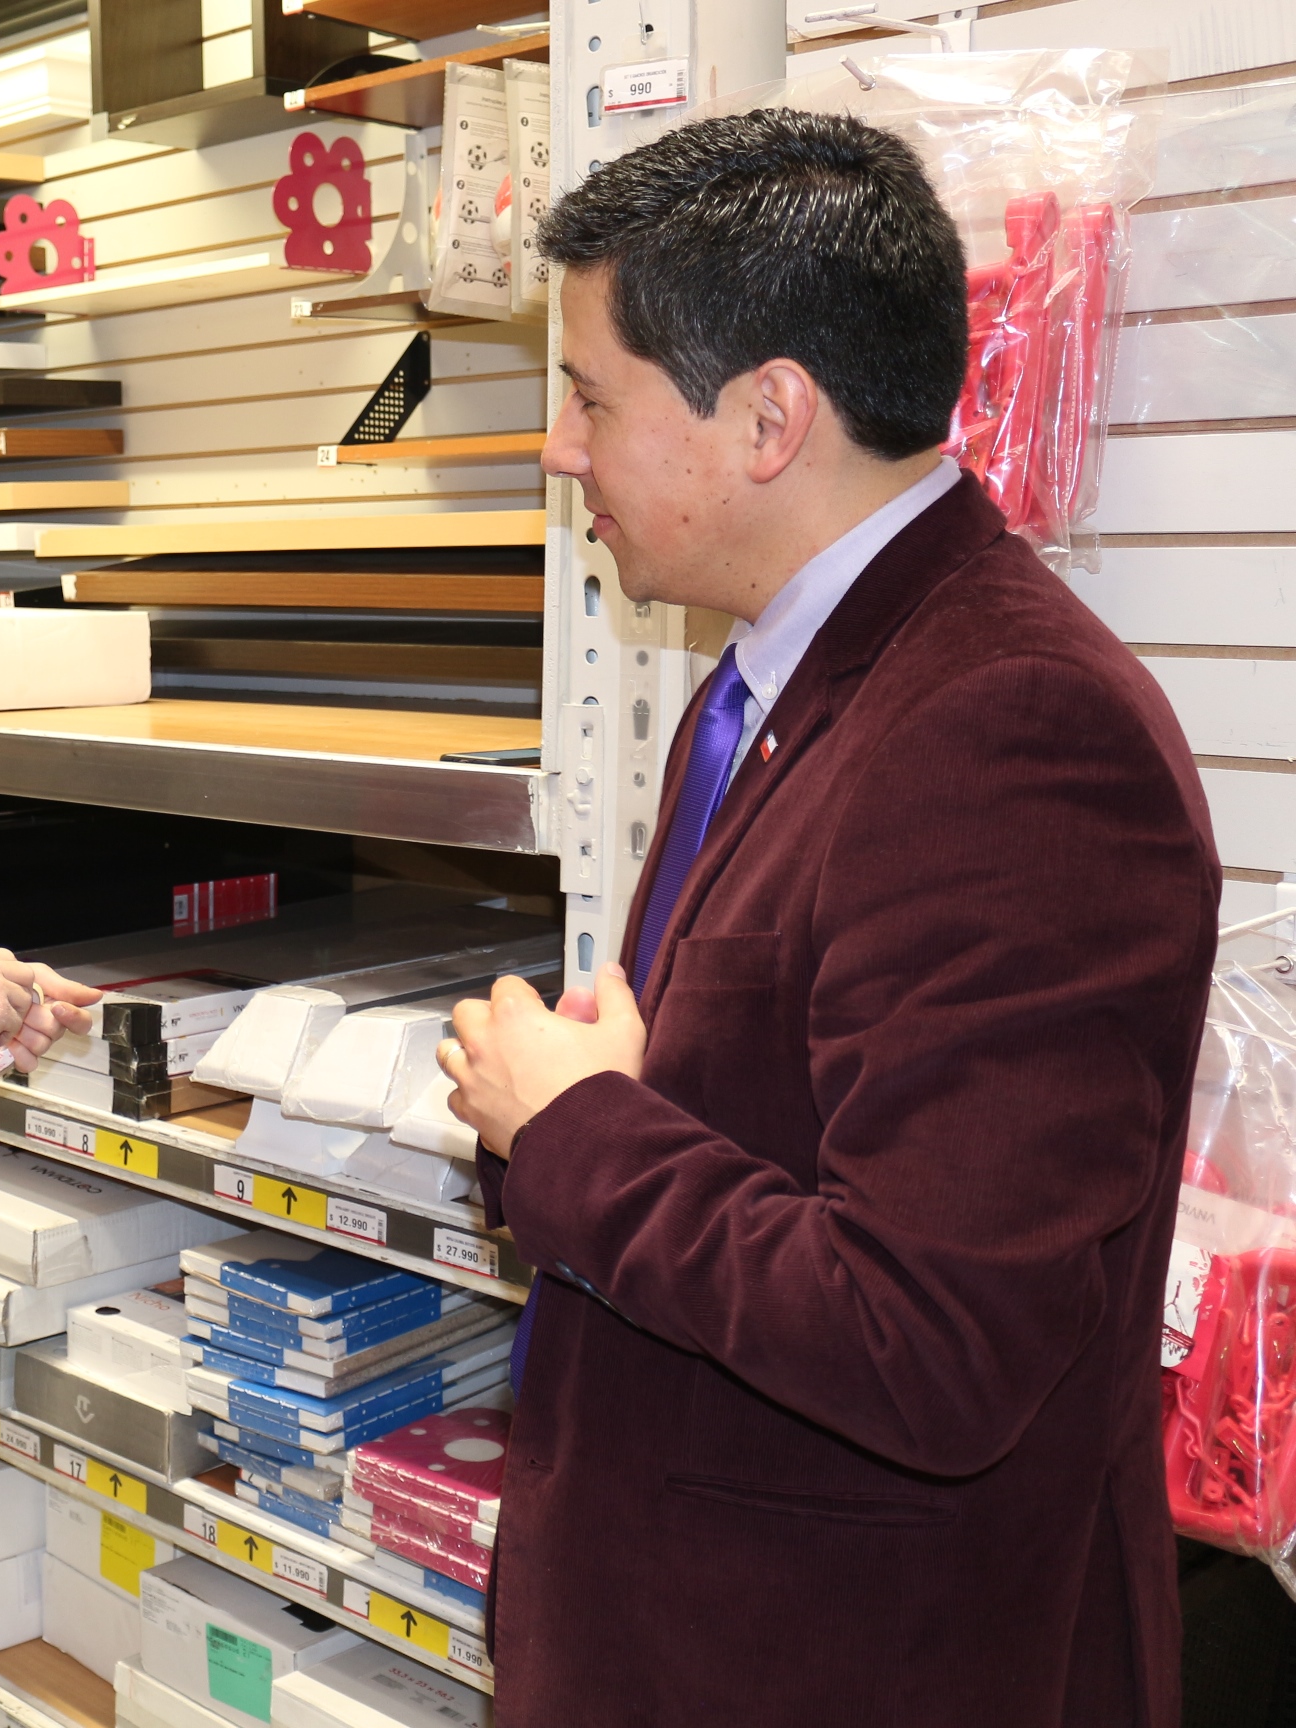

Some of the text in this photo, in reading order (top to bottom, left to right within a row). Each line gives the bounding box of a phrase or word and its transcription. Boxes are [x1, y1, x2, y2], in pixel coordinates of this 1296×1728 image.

[608, 81, 652, 98] $ 990
[82, 1133, 89, 1153] 8
[236, 1179, 245, 1200] 9
[338, 1214, 368, 1232] 12.990
[446, 1245, 479, 1263] 27.990
[69, 1459, 82, 1480] 17
[202, 1522, 216, 1543] 18
[283, 1563, 310, 1581] 11.990
[451, 1645, 482, 1667] 11.990
